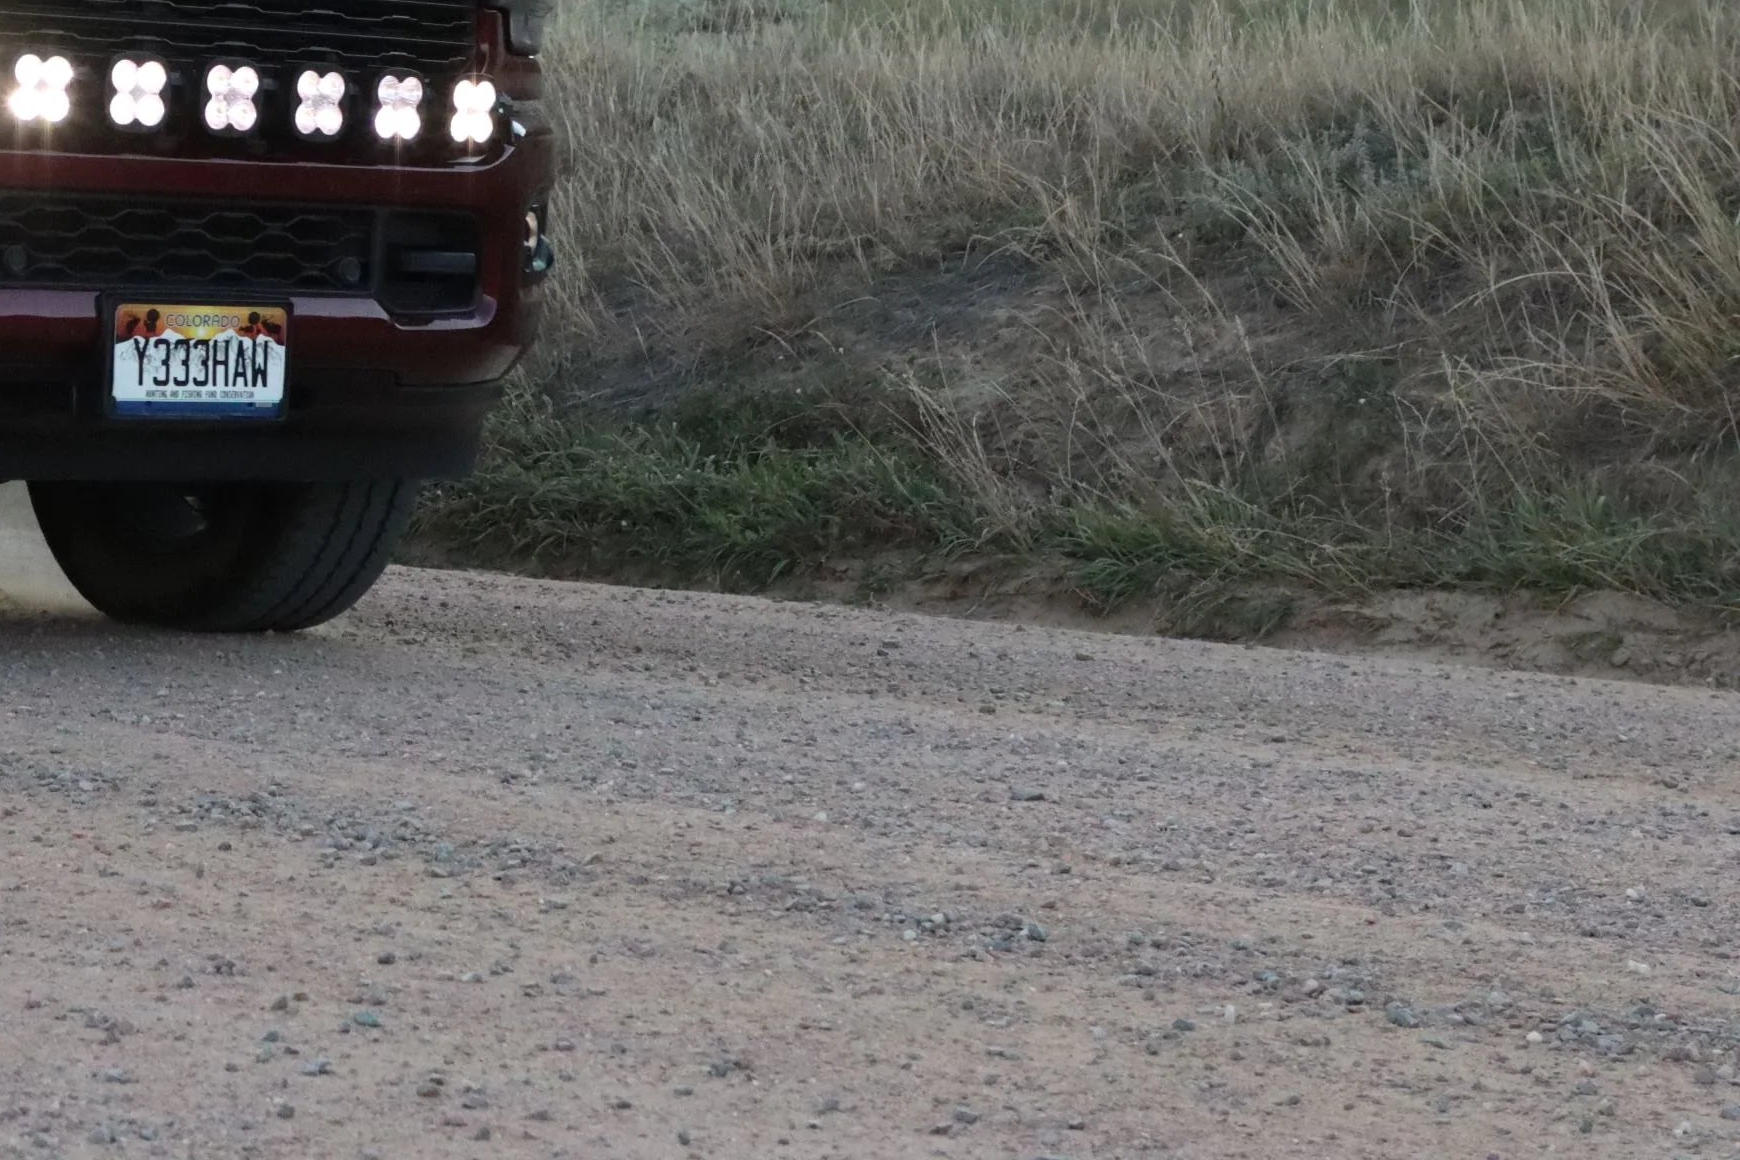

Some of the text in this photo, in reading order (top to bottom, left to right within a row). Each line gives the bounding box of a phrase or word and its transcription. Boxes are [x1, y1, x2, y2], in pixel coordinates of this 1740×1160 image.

[166, 313, 241, 328] COLORADO
[133, 338, 268, 387] Y333HAW
[145, 390, 168, 398] HUNTING
[182, 390, 202, 398] FISHING
